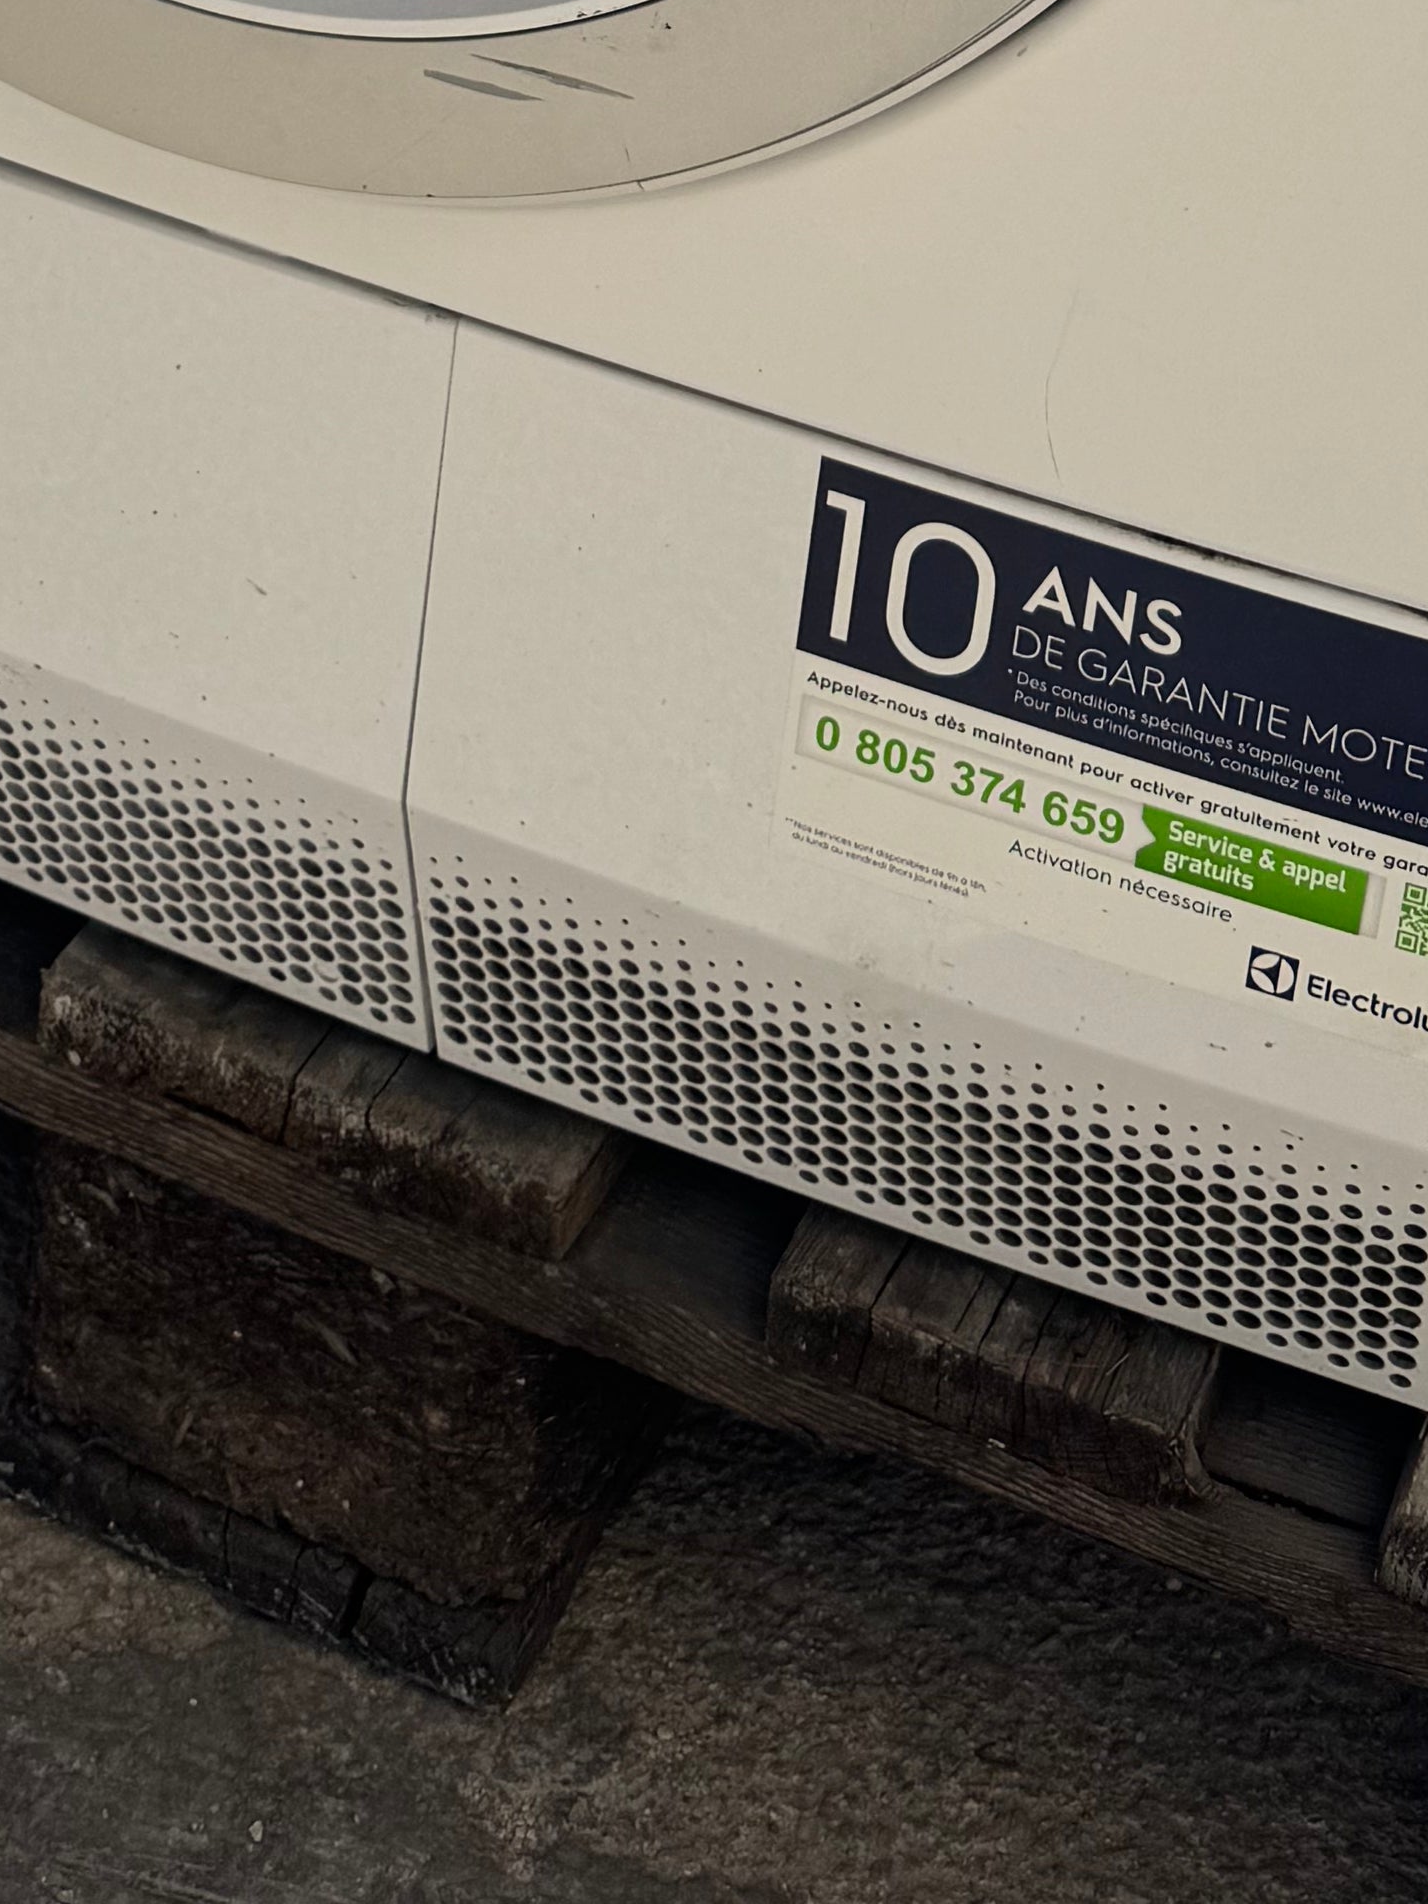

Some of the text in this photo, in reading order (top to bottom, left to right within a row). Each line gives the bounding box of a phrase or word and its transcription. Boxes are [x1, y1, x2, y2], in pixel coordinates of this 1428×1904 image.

[825, 490, 996, 676] 10
[1022, 565, 1182, 655] ANS
[1012, 625, 1065, 670] DE
[1078, 648, 1290, 739] GARANTIE
[1052, 684, 1136, 721] conditions
[1141, 712, 1233, 750] spécifiques
[807, 670, 929, 721] Appelez-nous
[934, 711, 967, 733] dès
[972, 725, 1073, 768] maintenant
[1080, 760, 1124, 784] pour
[1130, 776, 1195, 805] activer
[1200, 798, 1321, 845] gratuitement
[1327, 835, 1376, 861] votre
[815, 715, 1125, 844] 0 805 374 659
[1014, 690, 1051, 714] Pour
[1055, 703, 1088, 725] plus
[1221, 758, 1299, 790] consultez
[1305, 779, 1319, 796] le
[1323, 787, 1352, 806] site
[1008, 839, 1232, 923] Activation nécessaire
[1163, 848, 1254, 891] gratuits
[1168, 820, 1347, 893] Service & appel
